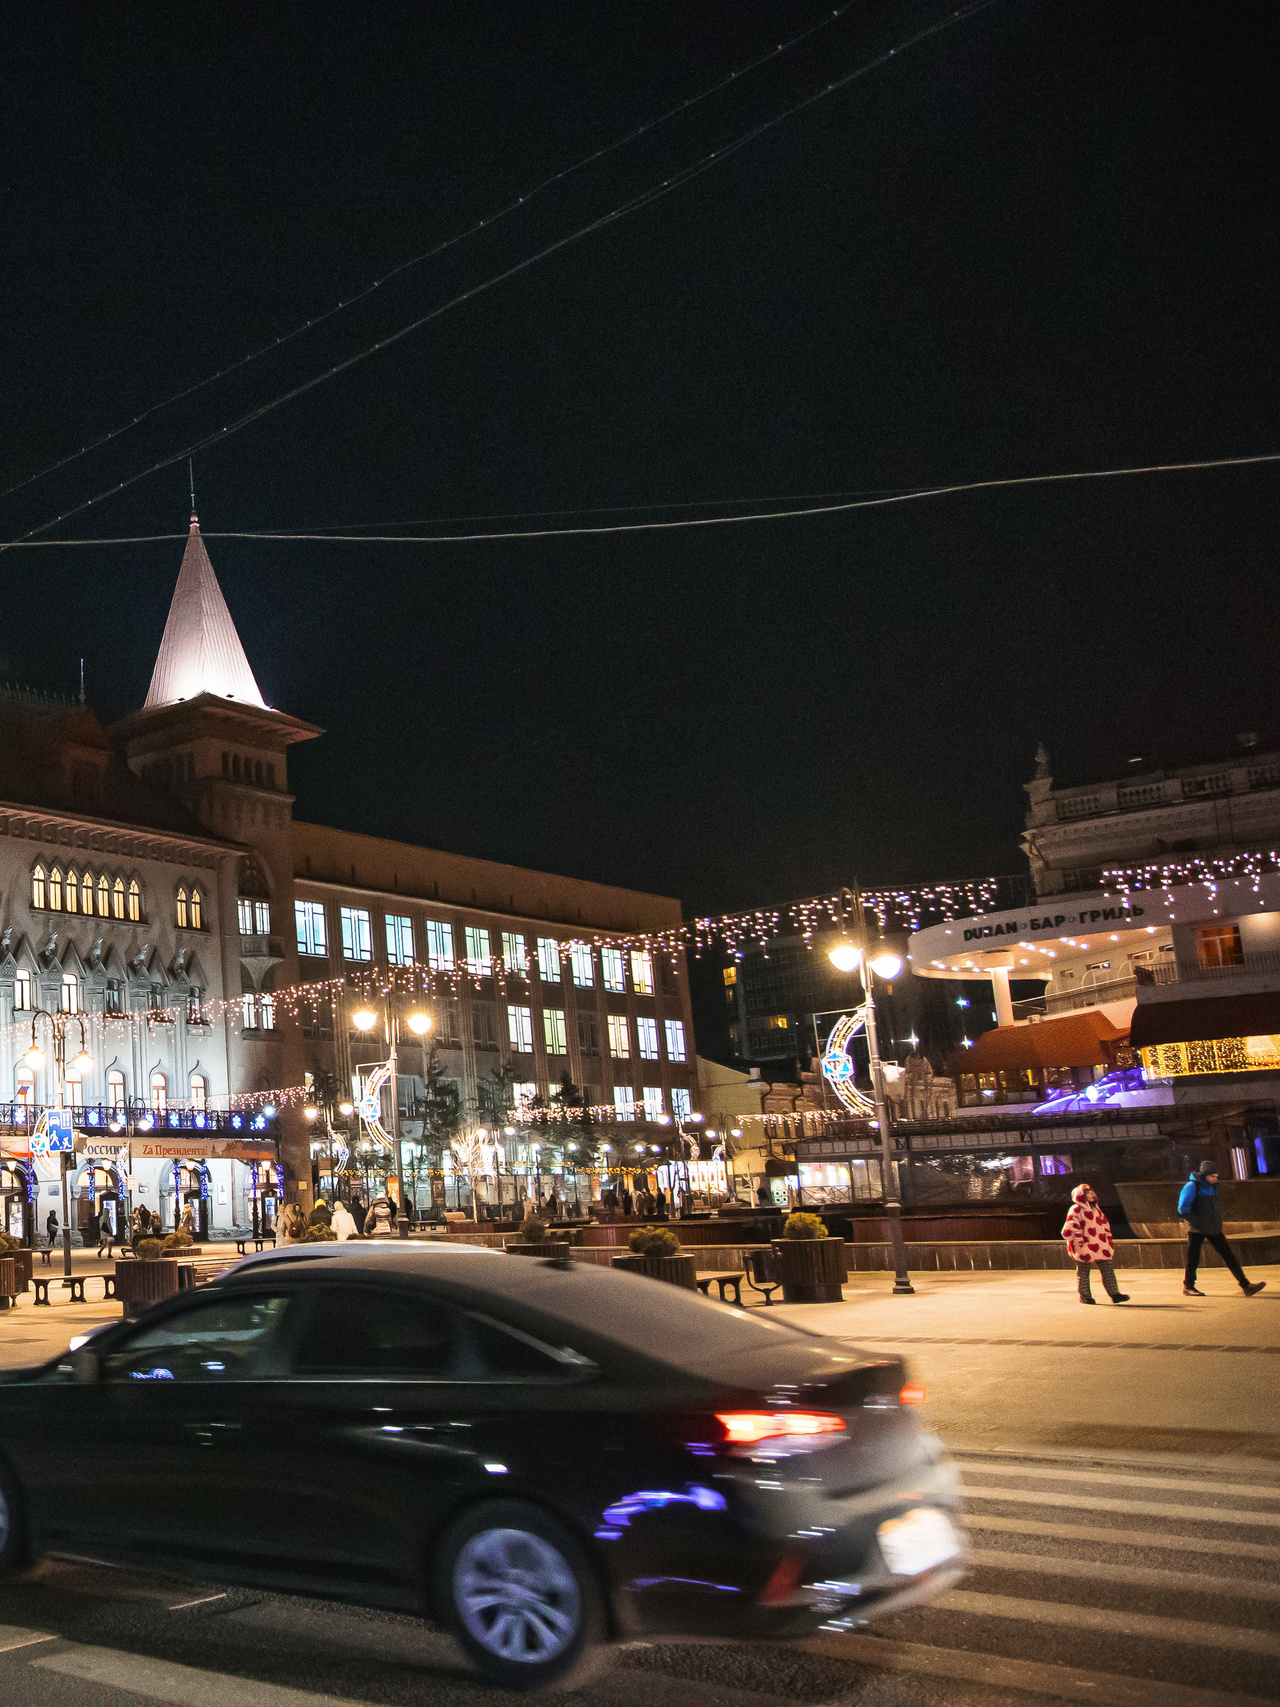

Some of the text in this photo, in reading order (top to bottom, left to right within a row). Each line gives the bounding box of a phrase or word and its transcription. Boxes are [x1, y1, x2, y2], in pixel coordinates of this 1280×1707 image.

[963, 905, 1145, 941] DURAN БАР ГРИЛЬ
[155, 1144, 208, 1157] Президента!
